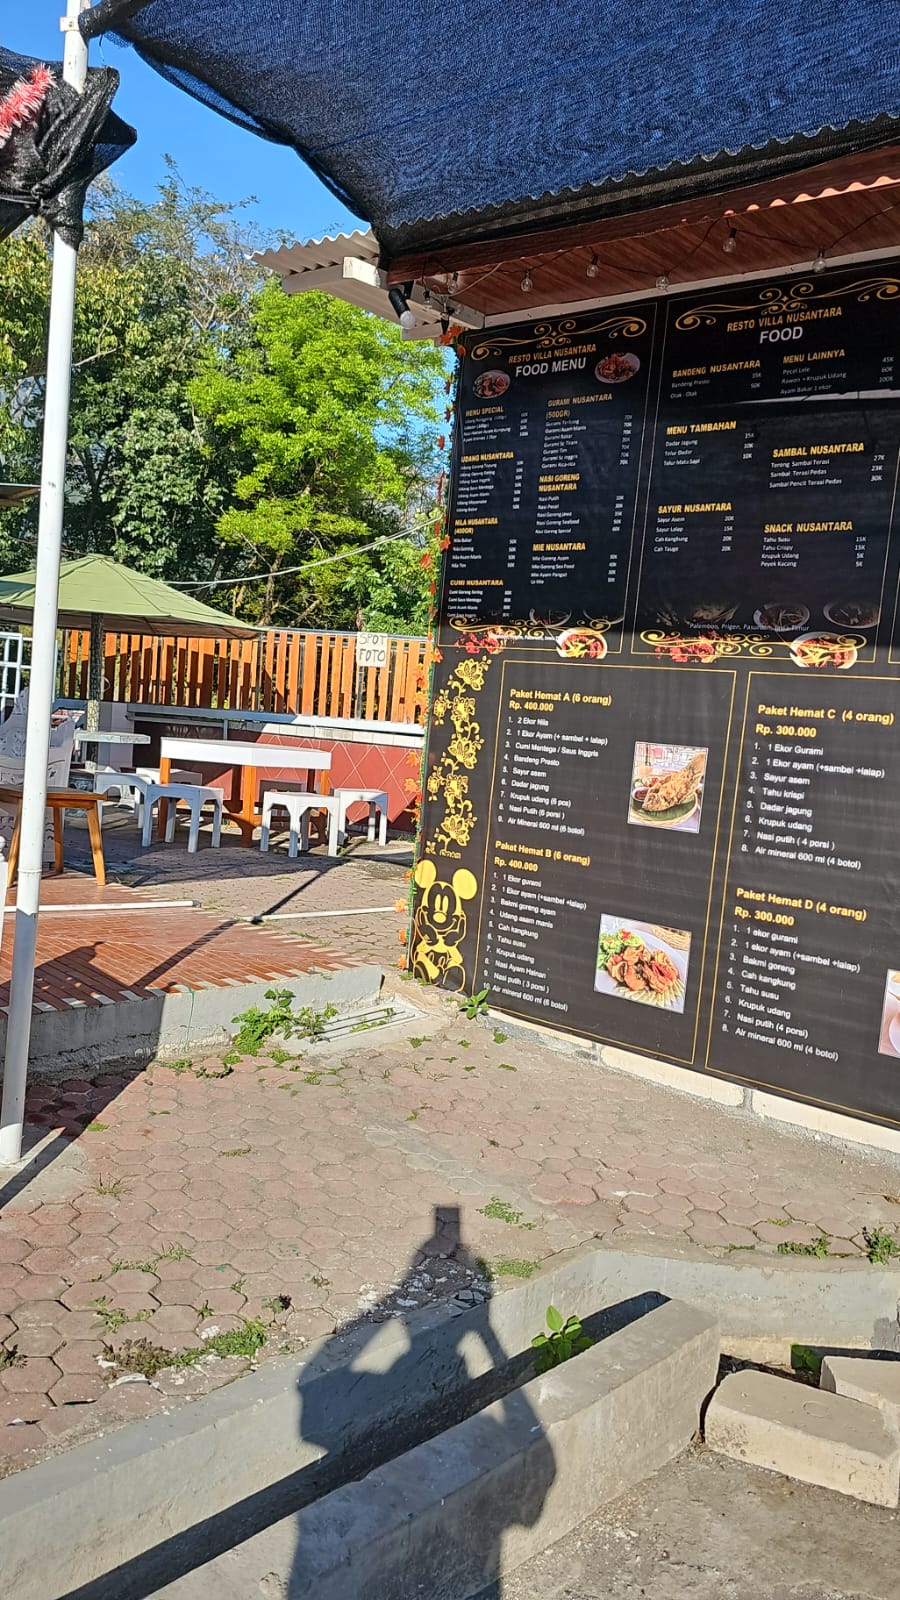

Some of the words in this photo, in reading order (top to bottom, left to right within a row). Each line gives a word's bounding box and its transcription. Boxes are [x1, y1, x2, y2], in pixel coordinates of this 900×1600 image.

[727, 319, 755, 332] RESTO
[759, 315, 783, 327] VILLA
[786, 307, 842, 323] NUSANTARA
[759, 327, 803, 344] FOOD
[508, 353, 531, 363] RESTO
[533, 350, 552, 360] VILLA
[554, 344, 596, 357] NUSANTARA
[783, 354, 805, 364] MENU
[807, 349, 845, 361] LAINNYA
[515, 363, 549, 377] FOOD
[552, 357, 586, 372] MENU
[672, 367, 706, 378] BANDENG
[710, 360, 760, 373] NUSANTARA
[572, 394, 612, 404] NUSANTARA
[465, 409, 481, 417] MENU
[667, 426, 688, 435] MENU
[690, 421, 737, 433] TAMBAHAN
[480, 452, 514, 461] NUSANTARA
[773, 447, 807, 458] SAMBAL
[810, 443, 864, 455] NUSANTARA
[539, 475, 554, 483] NASI
[554, 473, 580, 482] GORENG
[539, 483, 577, 492] NUSANTARA
[658, 505, 682, 514] SAYUR
[684, 502, 732, 513] NUSANTARA
[467, 517, 498, 525] NUSANTARA
[764, 523, 793, 533] SNACK
[796, 521, 853, 532] NUSANTARA
[533, 543, 545, 551] MIE
[545, 542, 586, 551] NUSANTARA
[359, 633, 386, 646] SPOT
[358, 649, 386, 662] FOTO
[758, 704, 787, 716] Paket
[790, 706, 825, 718] Hemat
[827, 709, 836, 719] C
[842, 710, 853, 722] (4
[855, 713, 894, 725] orang)
[755, 723, 773, 736] Rp.
[776, 725, 817, 738] 300.000
[774, 743, 793, 753] Ekor
[794, 745, 824, 756] Gurami
[772, 758, 791, 768] Ekor
[792, 762, 814, 770] ayam
[763, 773, 787, 783] Sayur
[762, 787, 782, 797] Tahu
[783, 790, 805, 800] krispi
[760, 802, 785, 812] Dadar
[784, 805, 812, 818] jagung
[758, 817, 786, 827] Krupuk
[787, 821, 813, 833] udang
[755, 846, 766, 854] Air
[767, 849, 797, 859] mineral
[797, 852, 814, 862] 600
[826, 856, 835, 866] (4
[837, 858, 861, 870] botol)
[736, 887, 766, 902] Paket
[767, 893, 802, 908] Hemat
[804, 899, 814, 910] D
[816, 902, 827, 913] (4
[829, 906, 867, 921] orang)
[734, 906, 751, 919] Rp.
[754, 910, 794, 926] 300.000
[752, 929, 770, 938] ekor
[771, 933, 798, 944] gurami
[751, 943, 769, 953] ekor
[769, 948, 791, 958] ayam
[743, 955, 767, 967] Bakmi
[768, 962, 795, 975] goreng
[741, 970, 757, 980] Cah
[758, 974, 796, 991] kangkung
[740, 984, 759, 996] Tahu
[761, 990, 779, 1000] susu
[738, 998, 765, 1012] Krupuk
[767, 1007, 791, 1020] udang
[737, 1013, 754, 1024] Nasi
[755, 1019, 774, 1029] putih
[776, 1023, 784, 1032] (4
[785, 1027, 808, 1039] porsi)
[735, 1027, 746, 1037] Air
[747, 1032, 776, 1044] mineral
[777, 1038, 792, 1049] 600
[805, 1045, 813, 1055] (4
[815, 1047, 839, 1062] botol)
